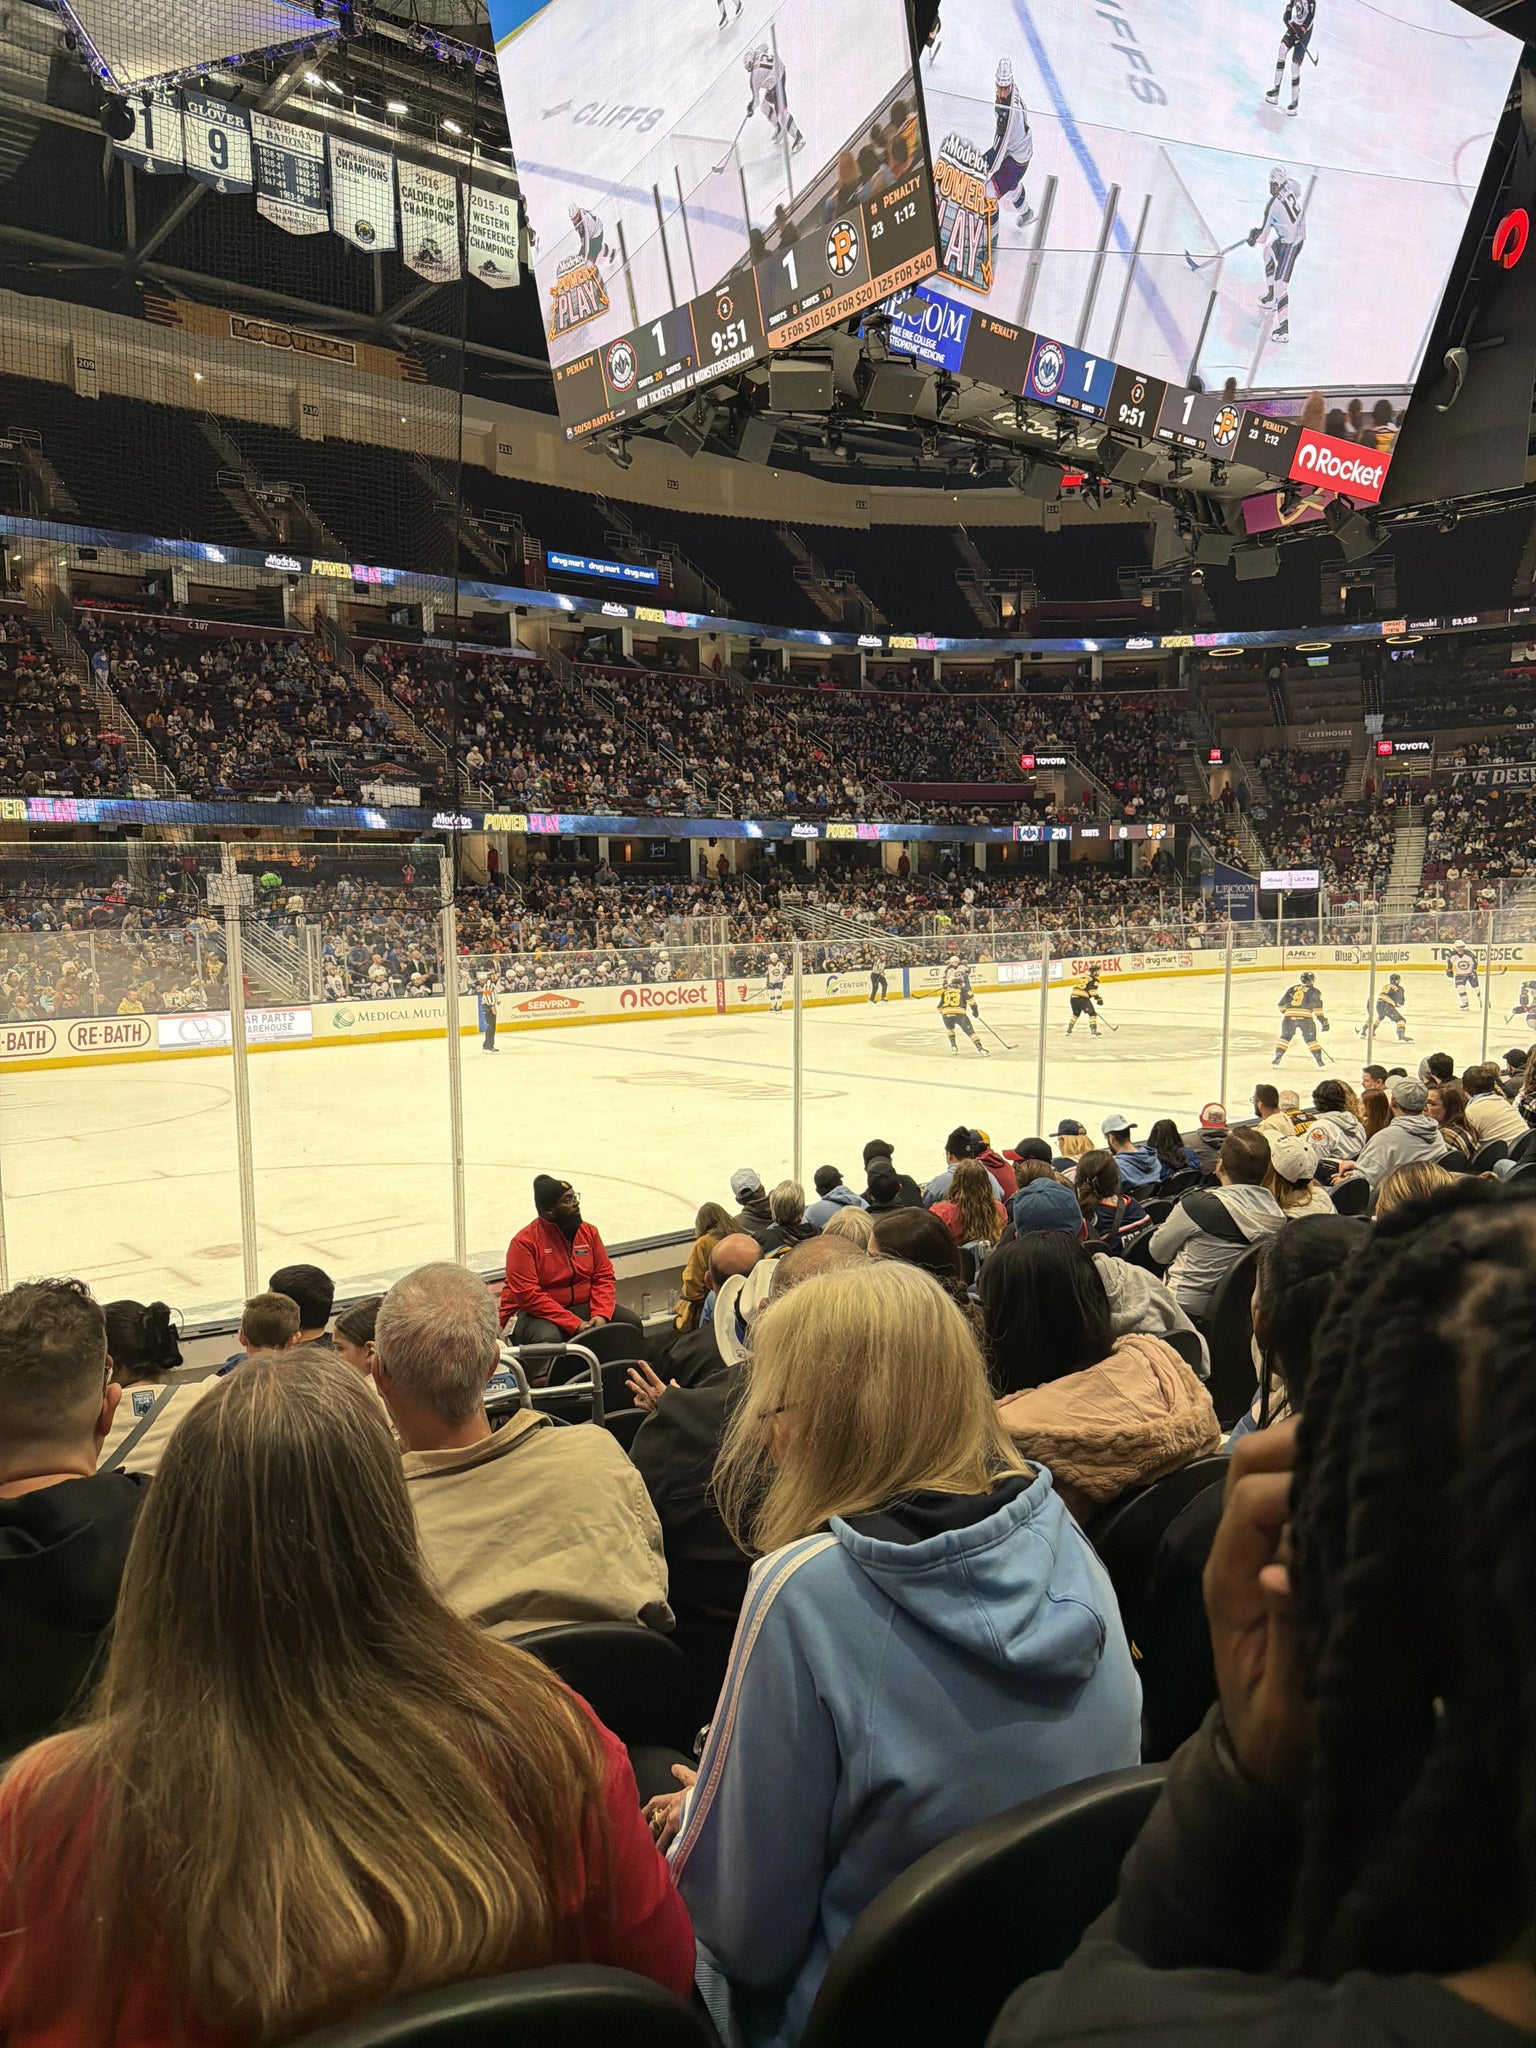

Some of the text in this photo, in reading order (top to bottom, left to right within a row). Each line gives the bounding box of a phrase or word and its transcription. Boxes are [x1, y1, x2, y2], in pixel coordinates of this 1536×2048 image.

[188, 102, 246, 128] GLOVER
[573, 102, 666, 134] CLIFFS
[140, 108, 154, 150] 1
[254, 116, 321, 142] CLEVELAND
[208, 128, 228, 170] 9
[266, 130, 312, 150] BARONS
[358, 155, 386, 170] DIVISION
[949, 135, 985, 169] Modelo
[336, 156, 388, 182] CHAMPIONS
[415, 174, 440, 190] 2016
[882, 176, 921, 208] PENALTY
[933, 159, 986, 216] POWER
[401, 186, 454, 210] CALDER CUP
[472, 194, 510, 216] 2015-16
[403, 200, 454, 226] CHAMPIONS
[472, 210, 510, 232] WESTERN
[870, 202, 916, 240] 23 1:12
[470, 236, 515, 260] CHAMPIONS
[833, 230, 852, 270] P
[556, 267, 592, 294] POWER
[782, 249, 798, 291] 1
[558, 282, 598, 330] PLAY
[722, 303, 728, 314] 2
[769, 310, 788, 326] SHOTS
[792, 305, 798, 316] 8
[822, 286, 832, 300] 19
[780, 254, 932, 344] 5 FOR $10 50 FOR $20 125 FOR $40
[651, 320, 666, 357] 1
[710, 318, 748, 356] 9:51
[902, 326, 914, 338] ERIE
[914, 332, 937, 350] COLLEGE
[989, 322, 1019, 342] PENALTY
[890, 335, 946, 364] STEOPATHIC MEDICINE
[1039, 344, 1064, 365] CLEVELAND
[78, 358, 95, 370] 209
[566, 356, 594, 377] PENALTY
[654, 370, 663, 382] 20
[1083, 359, 1096, 392] 1
[636, 396, 649, 410] BUY
[648, 384, 672, 405] TICKETS
[672, 380, 686, 396] NOW
[686, 376, 694, 388] AT
[1135, 388, 1141, 398] 2
[304, 405, 319, 416] 210
[1070, 399, 1080, 410] 20
[1180, 394, 1196, 426] 1
[573, 418, 592, 436] 50/50
[592, 408, 616, 430] RAFFLE
[1118, 404, 1146, 428] 9:51
[1248, 428, 1280, 446] 23 1:12
[1262, 419, 1288, 436] PENALTY
[1314, 450, 1383, 489] Rocket
[310, 559, 352, 580] POWER
[552, 556, 585, 569] drug mart
[588, 562, 620, 574] drug mart
[624, 567, 654, 580] drug mart
[634, 606, 666, 623] POWER
[1410, 616, 1478, 628] oswald $3,553
[188, 621, 209, 630] C 107
[1160, 635, 1194, 648] POWER
[1394, 742, 1430, 750] TOYOTA
[1036, 757, 1066, 766] TOYOTA
[483, 813, 560, 833] POWER PLAY
[826, 824, 858, 838] POWER
[1052, 826, 1128, 840] 20 SHOTS 8
[1216, 884, 1255, 894] LECOM
[1145, 956, 1178, 966] drug mart
[1334, 949, 1352, 962] Blue
[1072, 957, 1122, 976] SEATGEEK
[639, 984, 708, 1008] Rocket
[839, 982, 868, 990] CENTURY
[527, 1000, 571, 1010] SERVPRO
[1290, 990, 1304, 1006] 9
[246, 1012, 296, 1025] AR PARTS
[358, 1008, 448, 1022] MEDICAL MUTU
[245, 1022, 294, 1034] AREHOUSE
